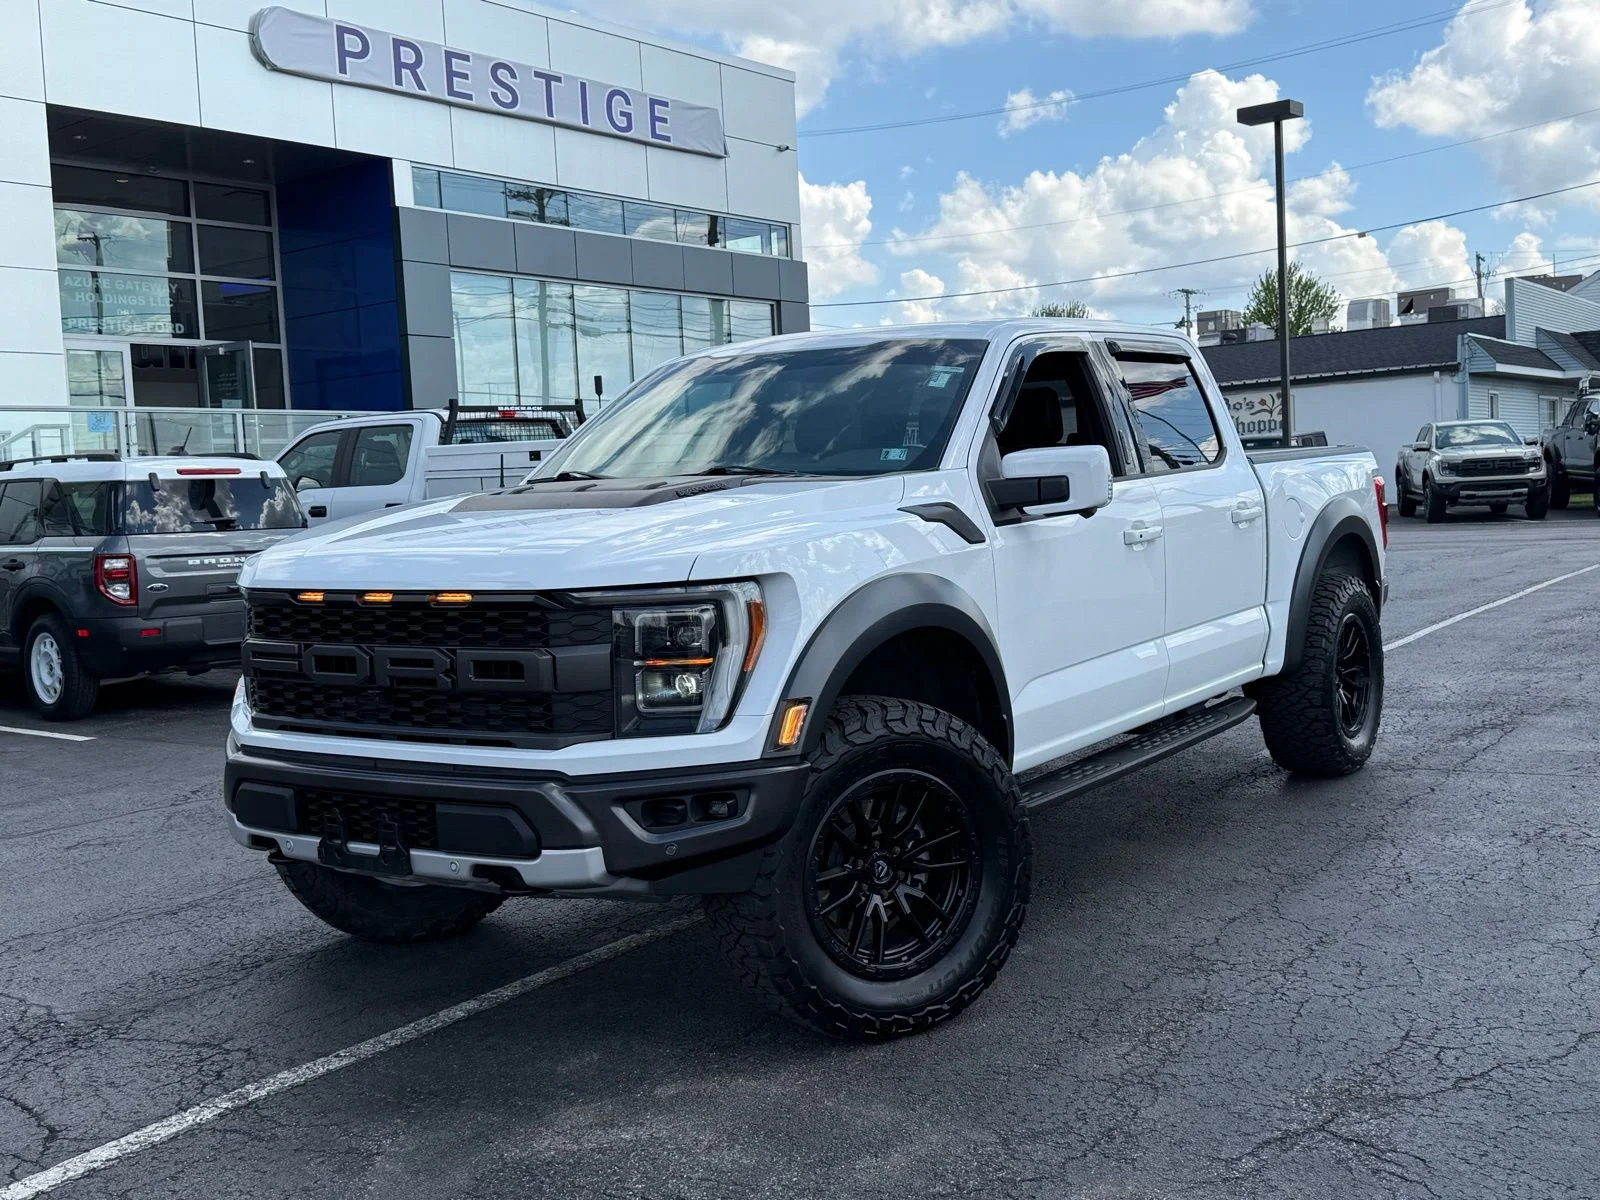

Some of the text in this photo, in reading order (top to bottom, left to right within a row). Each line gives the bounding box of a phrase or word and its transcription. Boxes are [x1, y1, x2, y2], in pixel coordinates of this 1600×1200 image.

[334, 23, 673, 143] PRESTIGE
[64, 276, 178, 293] AZURE GATEWAY
[75, 292, 174, 307] HOLDINGS LLC
[146, 321, 185, 334] FORD
[1231, 415, 1282, 435] hopp
[187, 556, 246, 565] BRON
[242, 638, 555, 693] FORD
